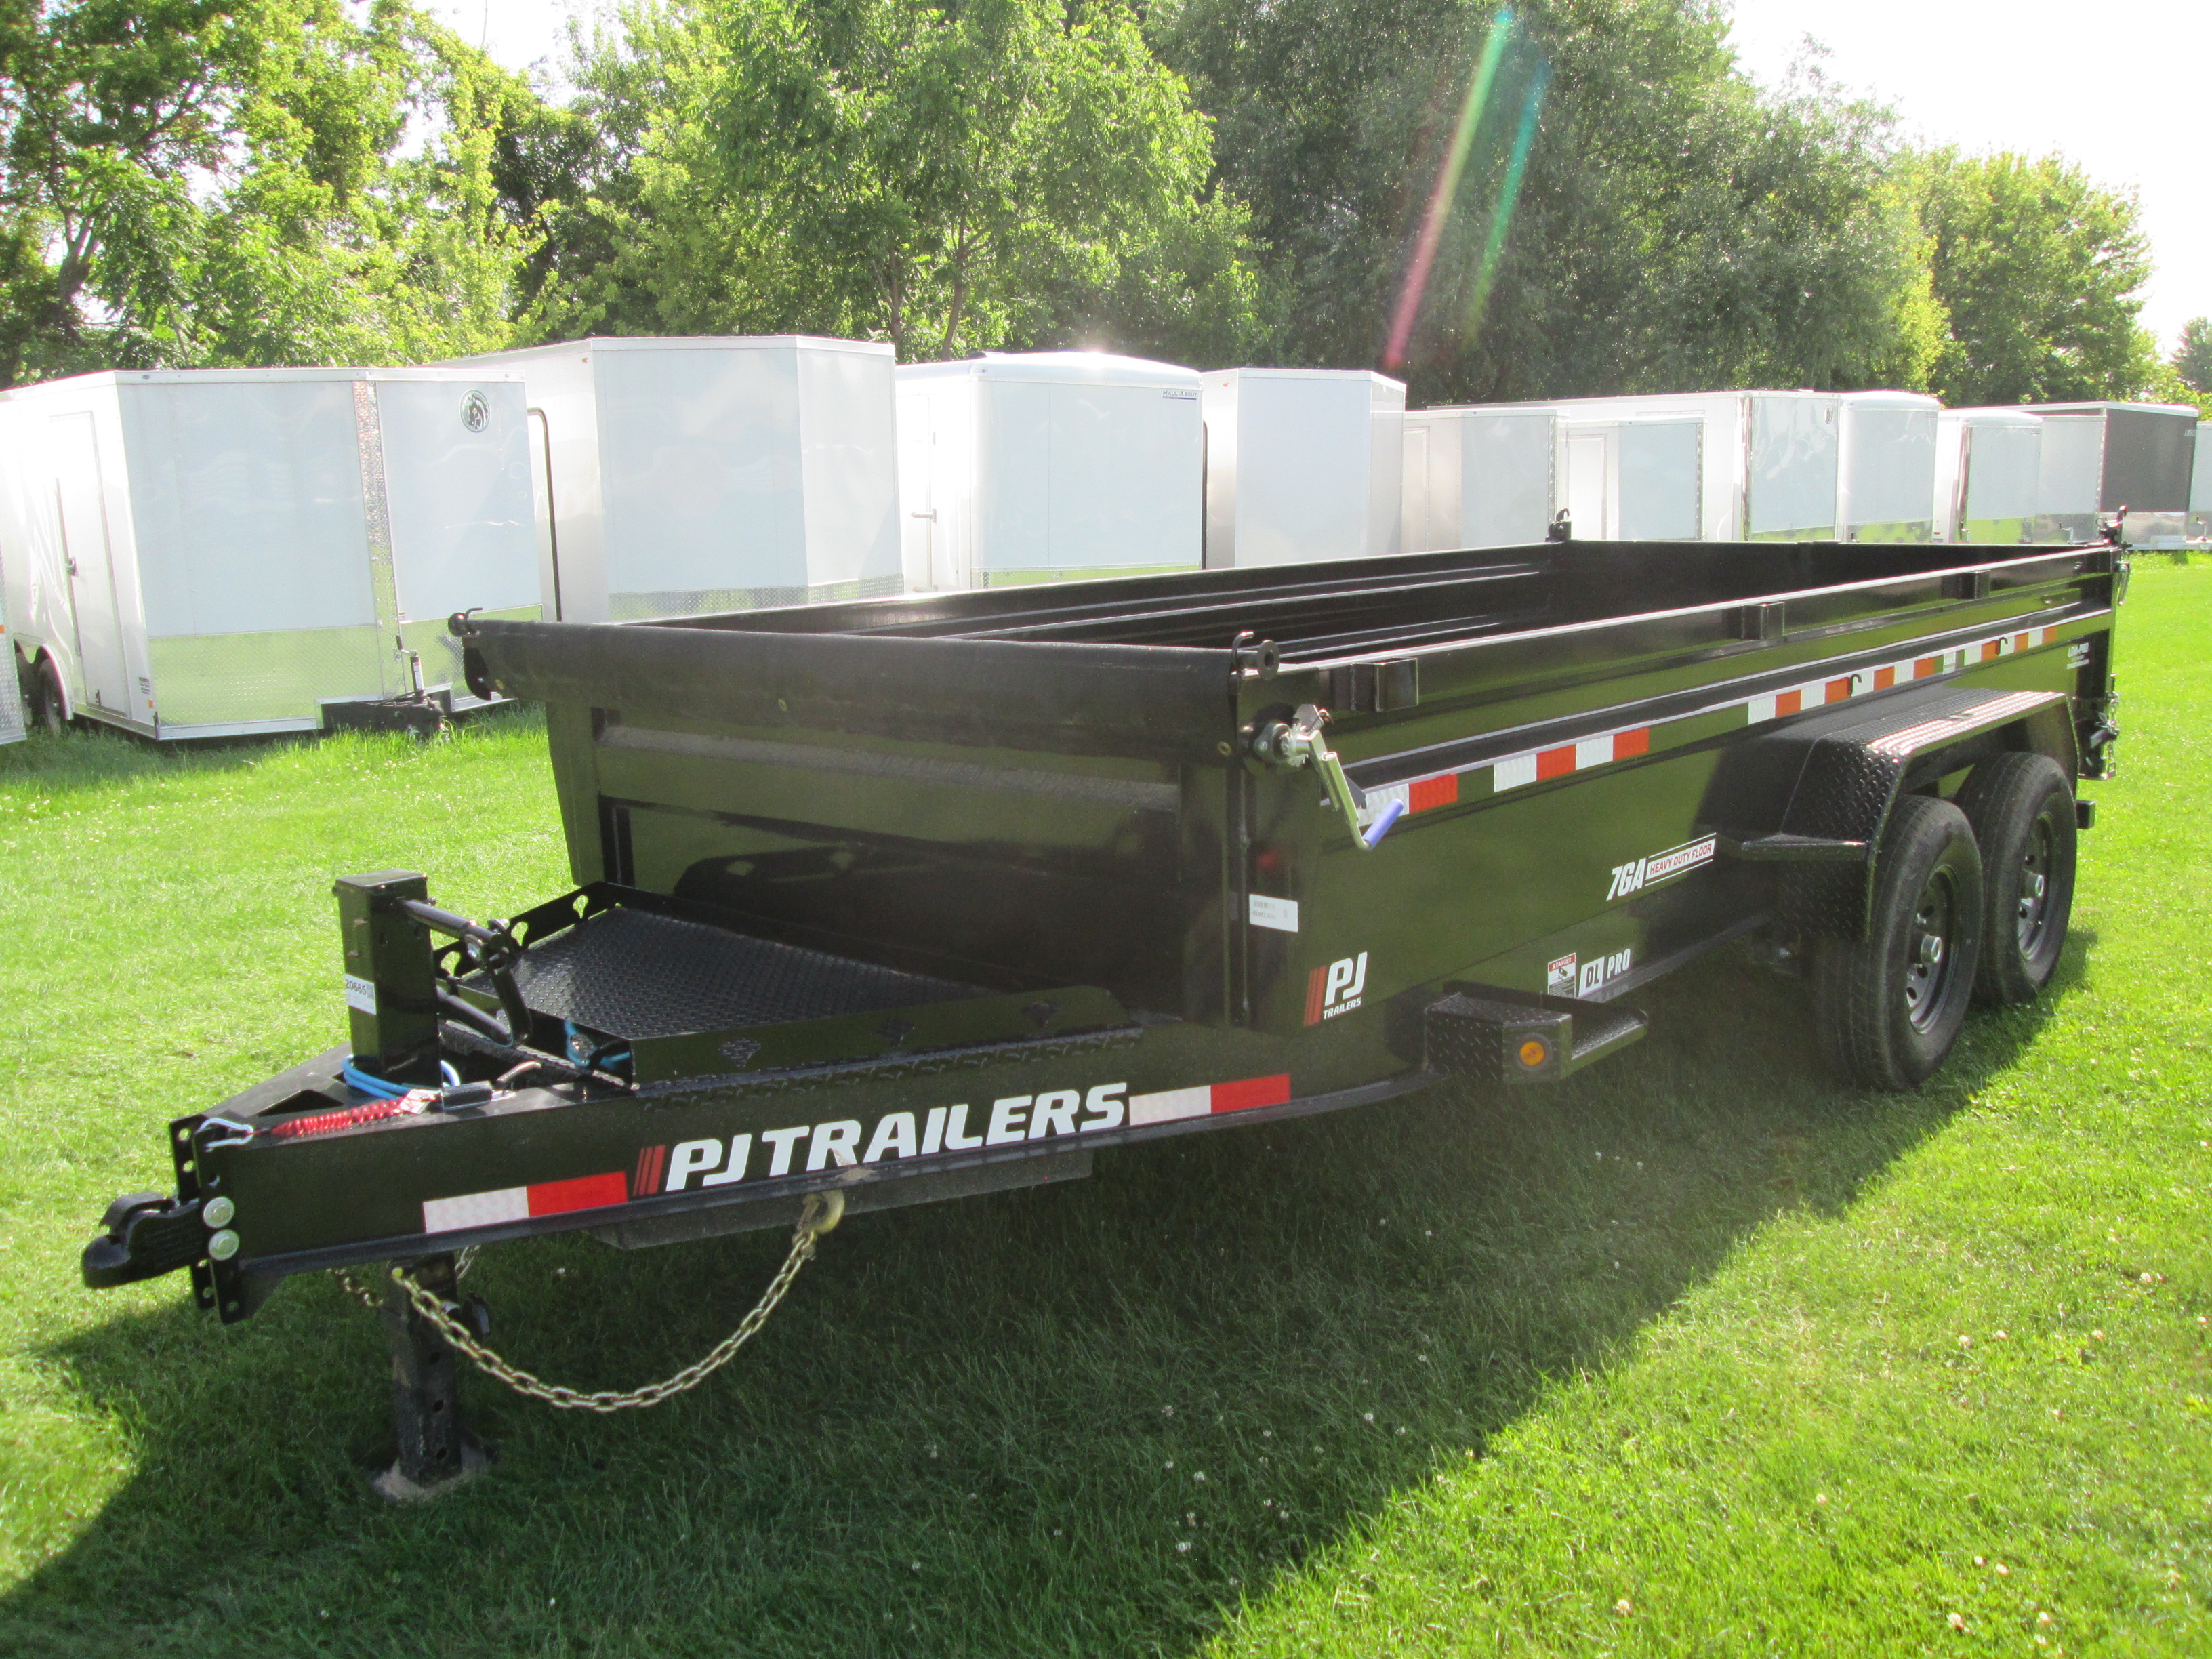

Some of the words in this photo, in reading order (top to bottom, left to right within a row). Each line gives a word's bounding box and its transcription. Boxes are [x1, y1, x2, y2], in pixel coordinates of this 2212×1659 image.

[1606, 857, 1647, 901] 7GA
[1650, 857, 1674, 876] HEAVY
[1673, 851, 1691, 866] DUTY
[1692, 843, 1712, 859] FLOOR
[1324, 951, 1368, 1007] PJ
[1555, 956, 1572, 968] DANGER
[1585, 963, 1599, 988] DL
[1606, 948, 1631, 979] PRO
[345, 979, 367, 995] 20665
[1323, 996, 1362, 1020] TRAILERS
[665, 1133, 752, 1191] PJ
[762, 1082, 1128, 1177] TRAILERS
